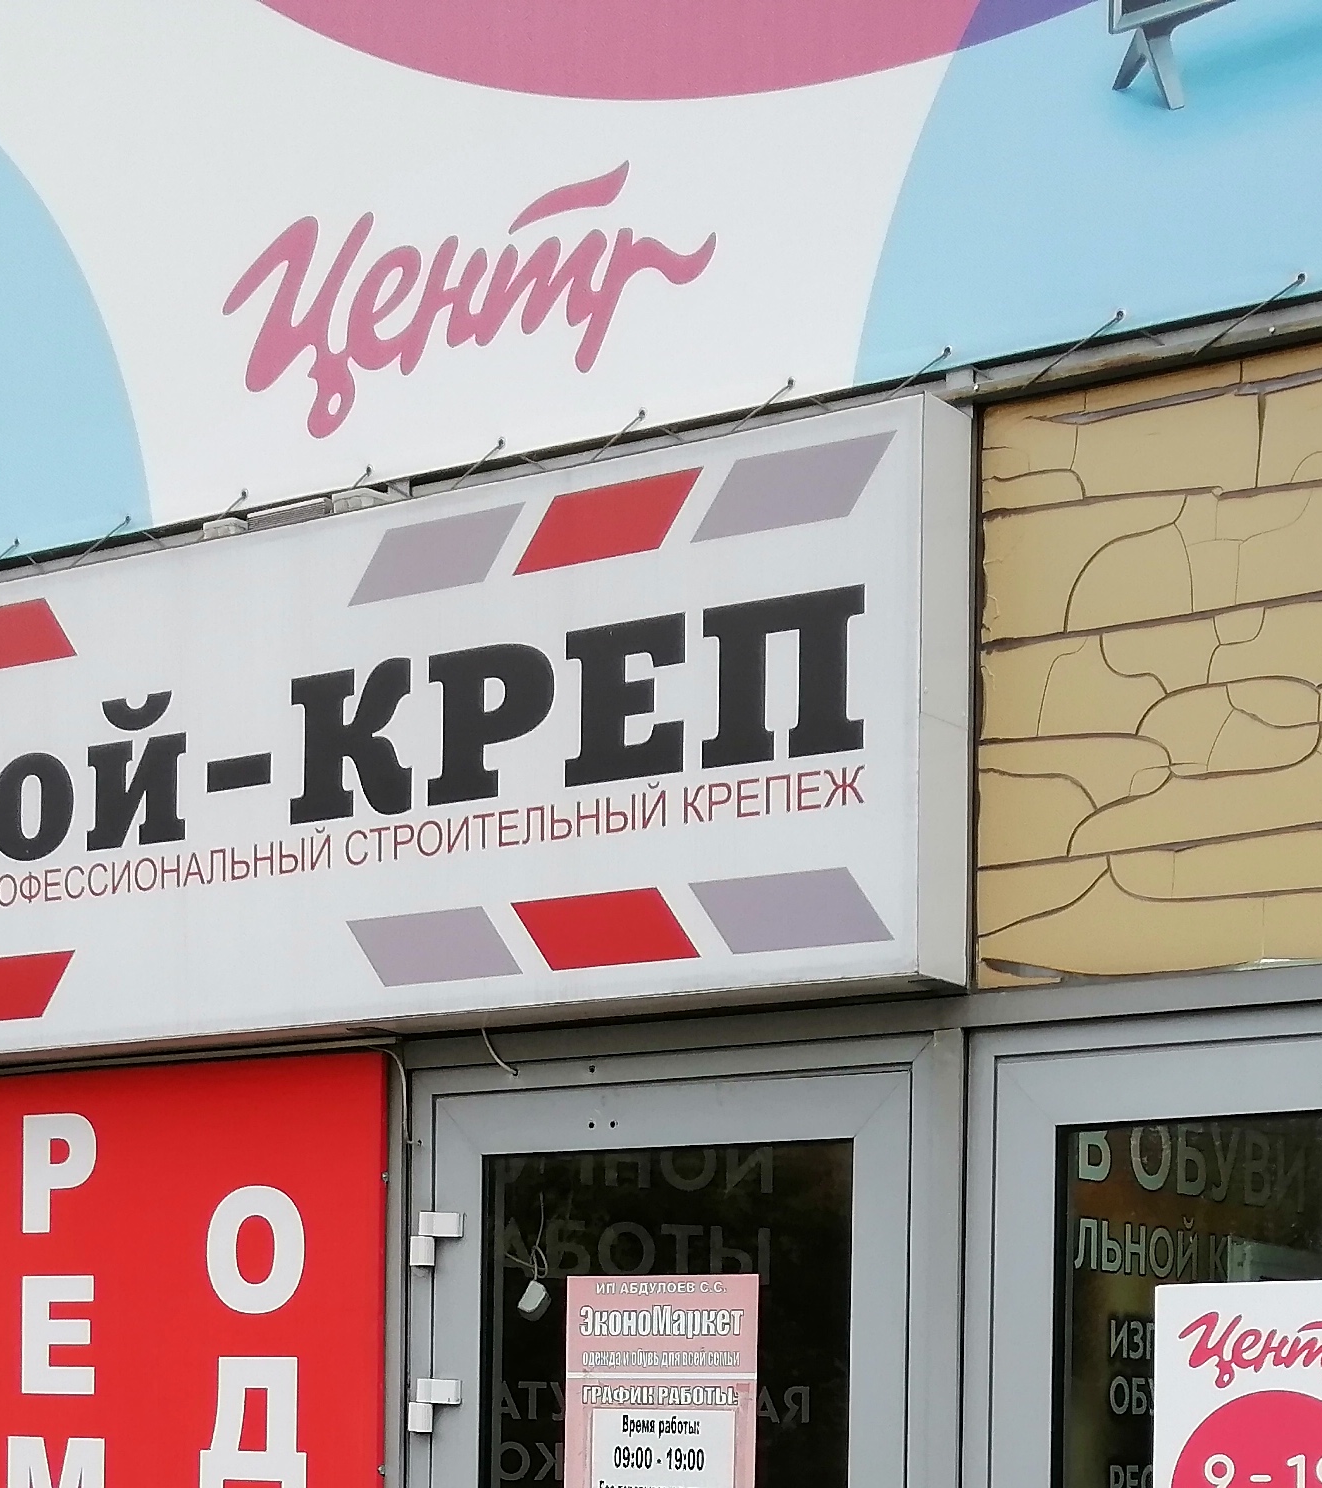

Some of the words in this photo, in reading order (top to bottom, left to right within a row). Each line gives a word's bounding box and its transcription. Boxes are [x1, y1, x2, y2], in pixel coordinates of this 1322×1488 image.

[222, 160, 717, 439] Центр
[343, 780, 671, 868] СТРОИТЕЛЬНЫЙ
[681, 763, 868, 825] КРЕПЕЖ
[1074, 1217, 1198, 1281] ЛЬНОЙ
[596, 1283, 615, 1294] ИП
[620, 1282, 695, 1295] АБДУЛОЕВ
[579, 1305, 744, 1339] ЭконоМаркет
[582, 1351, 621, 1368] одежда
[632, 1348, 659, 1368] обувь
[661, 1351, 679, 1368] для
[682, 1348, 705, 1367] всей
[708, 1351, 740, 1366] семьи
[582, 1385, 654, 1405] ГРАФИК
[658, 1386, 738, 1405] РАБОТЫ:
[622, 1415, 655, 1437] Время
[658, 1416, 700, 1438] работы:
[614, 1446, 652, 1469] 09:00
[666, 1448, 705, 1471] 19:00
